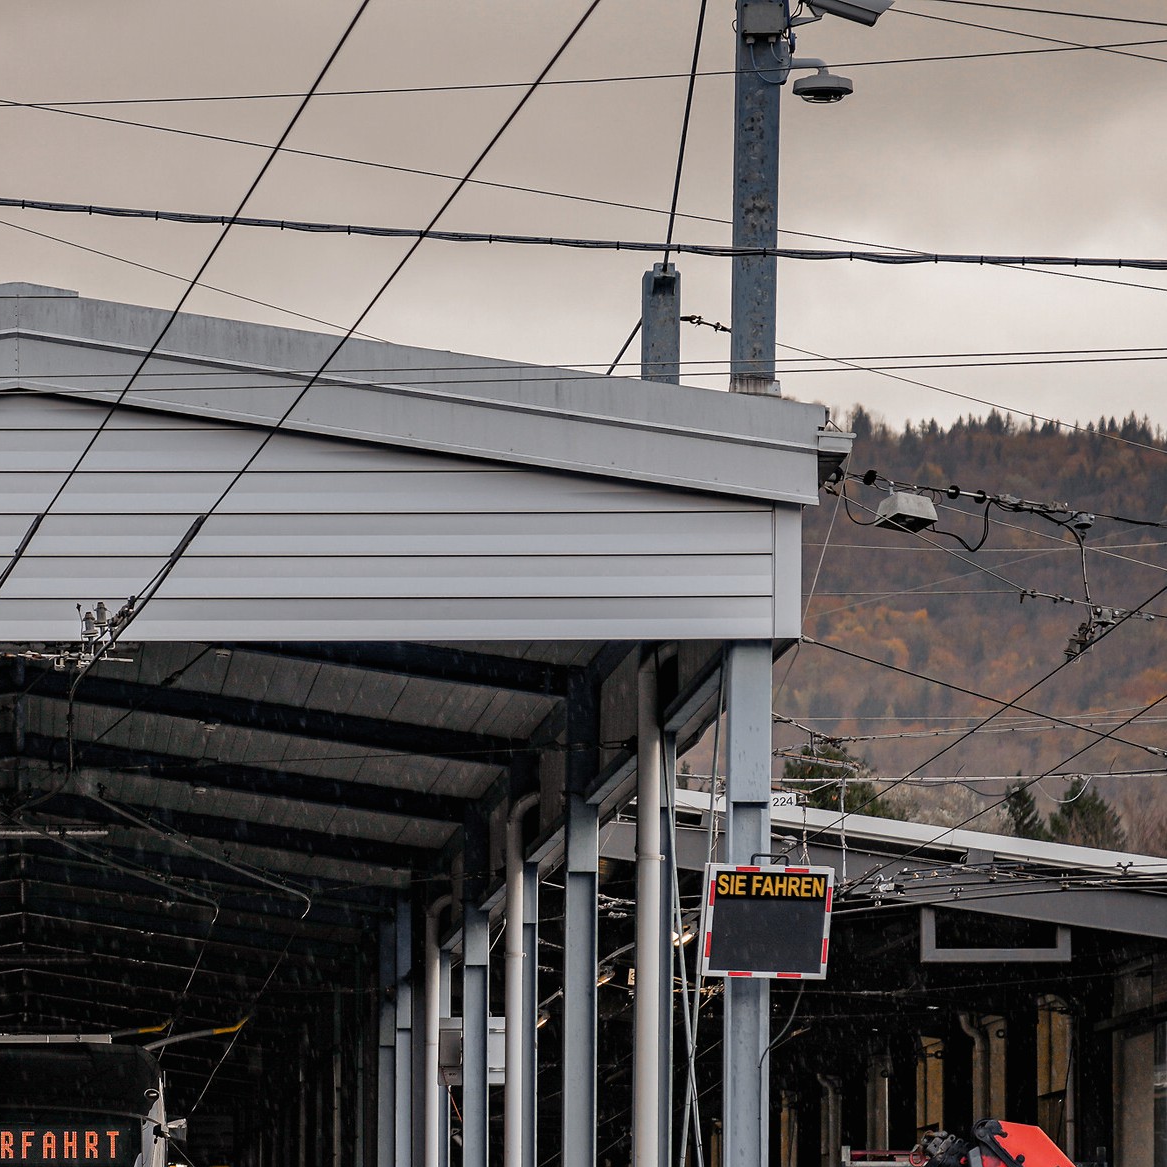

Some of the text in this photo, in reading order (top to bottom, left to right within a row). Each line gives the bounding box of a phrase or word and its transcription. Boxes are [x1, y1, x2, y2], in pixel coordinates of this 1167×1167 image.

[772, 797, 793, 806] 224
[717, 874, 825, 898] SIE FAHREN
